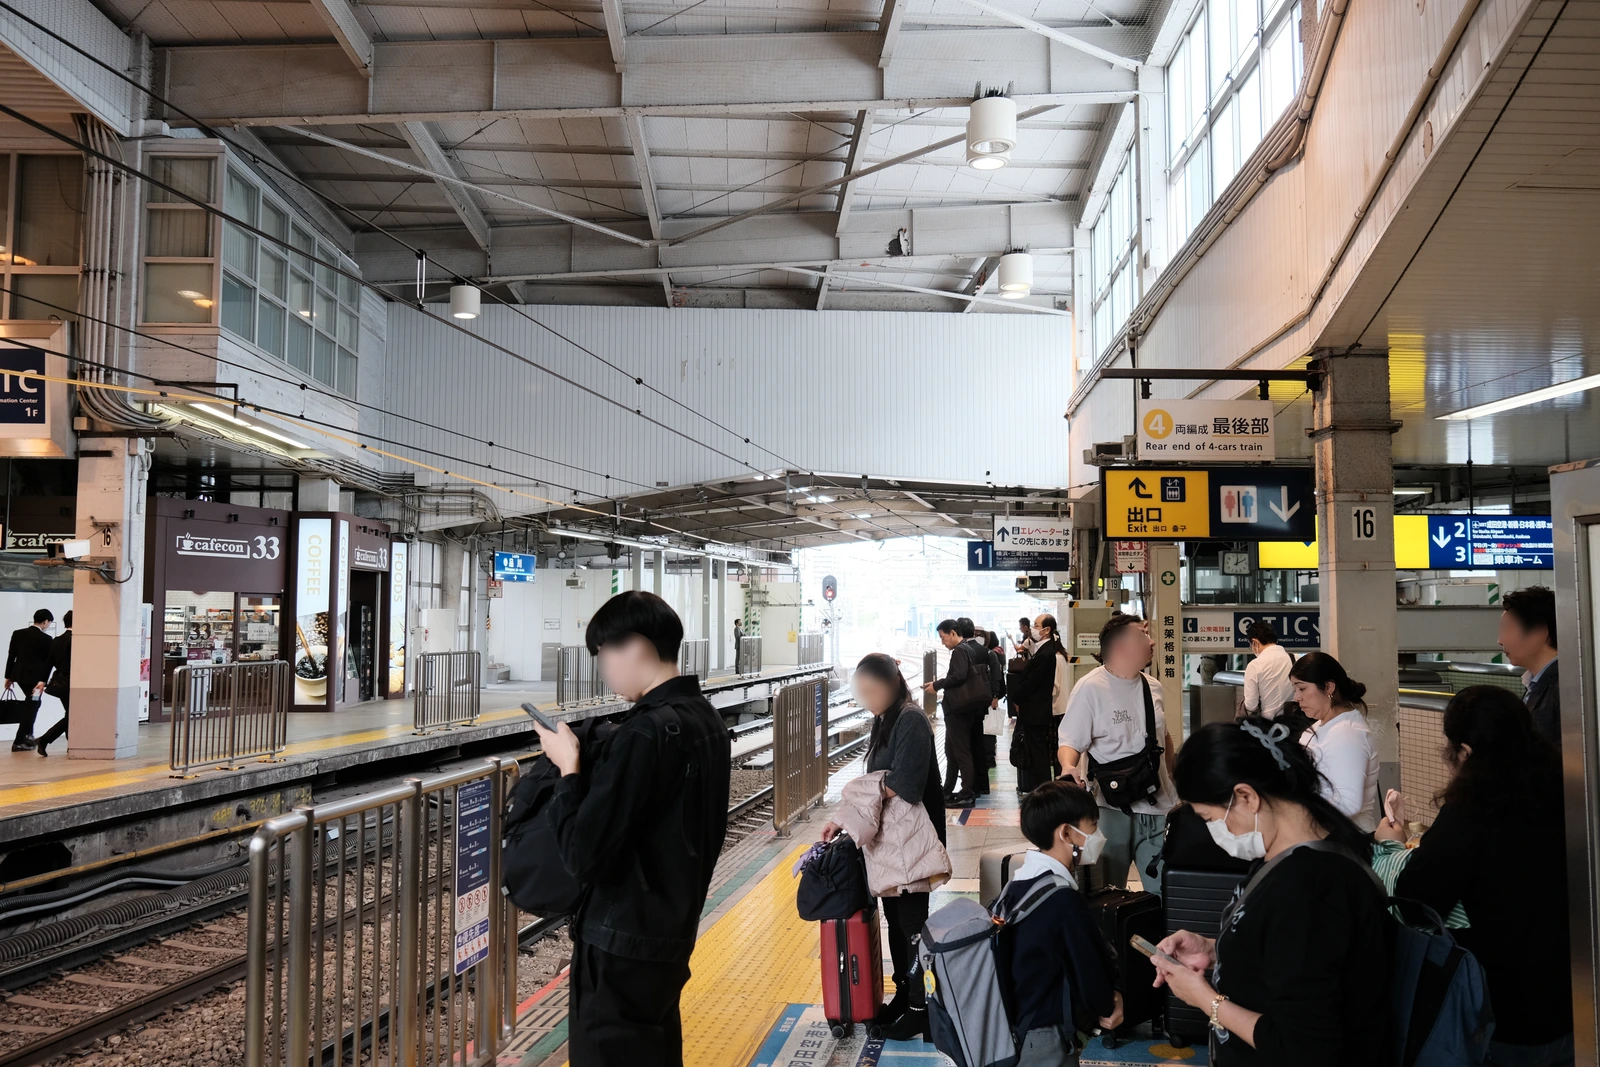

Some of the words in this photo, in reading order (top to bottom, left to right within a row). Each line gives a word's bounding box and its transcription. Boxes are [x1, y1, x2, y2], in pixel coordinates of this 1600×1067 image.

[4, 370, 37, 393] IC
[25, 407, 38, 417] 1F
[1148, 414, 1165, 434] 4
[1175, 424, 1208, 435] 両編成
[1212, 417, 1269, 435] 最後部
[1145, 442, 1167, 450] Rear
[1172, 442, 1190, 450] end
[1195, 442, 1205, 450] of
[1128, 507, 1162, 523] 出口
[1020, 527, 1070, 536] エレベーターは
[1128, 524, 1147, 532] Exit
[1354, 510, 1375, 539] 16
[1454, 522, 1465, 538] 2
[103, 527, 111, 546] 16
[1012, 537, 1069, 546] この先にあります
[194, 538, 244, 552] cafecon
[252, 536, 280, 560] 33
[974, 548, 983, 564] 1
[1455, 546, 1466, 562] 3
[306, 534, 322, 596] COFFEE
[378, 548, 387, 568] 33
[1495, 555, 1542, 564] 乗車ホーム
[394, 553, 403, 602] FOODS
[1111, 580, 1117, 589] 19
[1262, 617, 1309, 636] TIC
[1164, 616, 1175, 678] 担架格納箱
